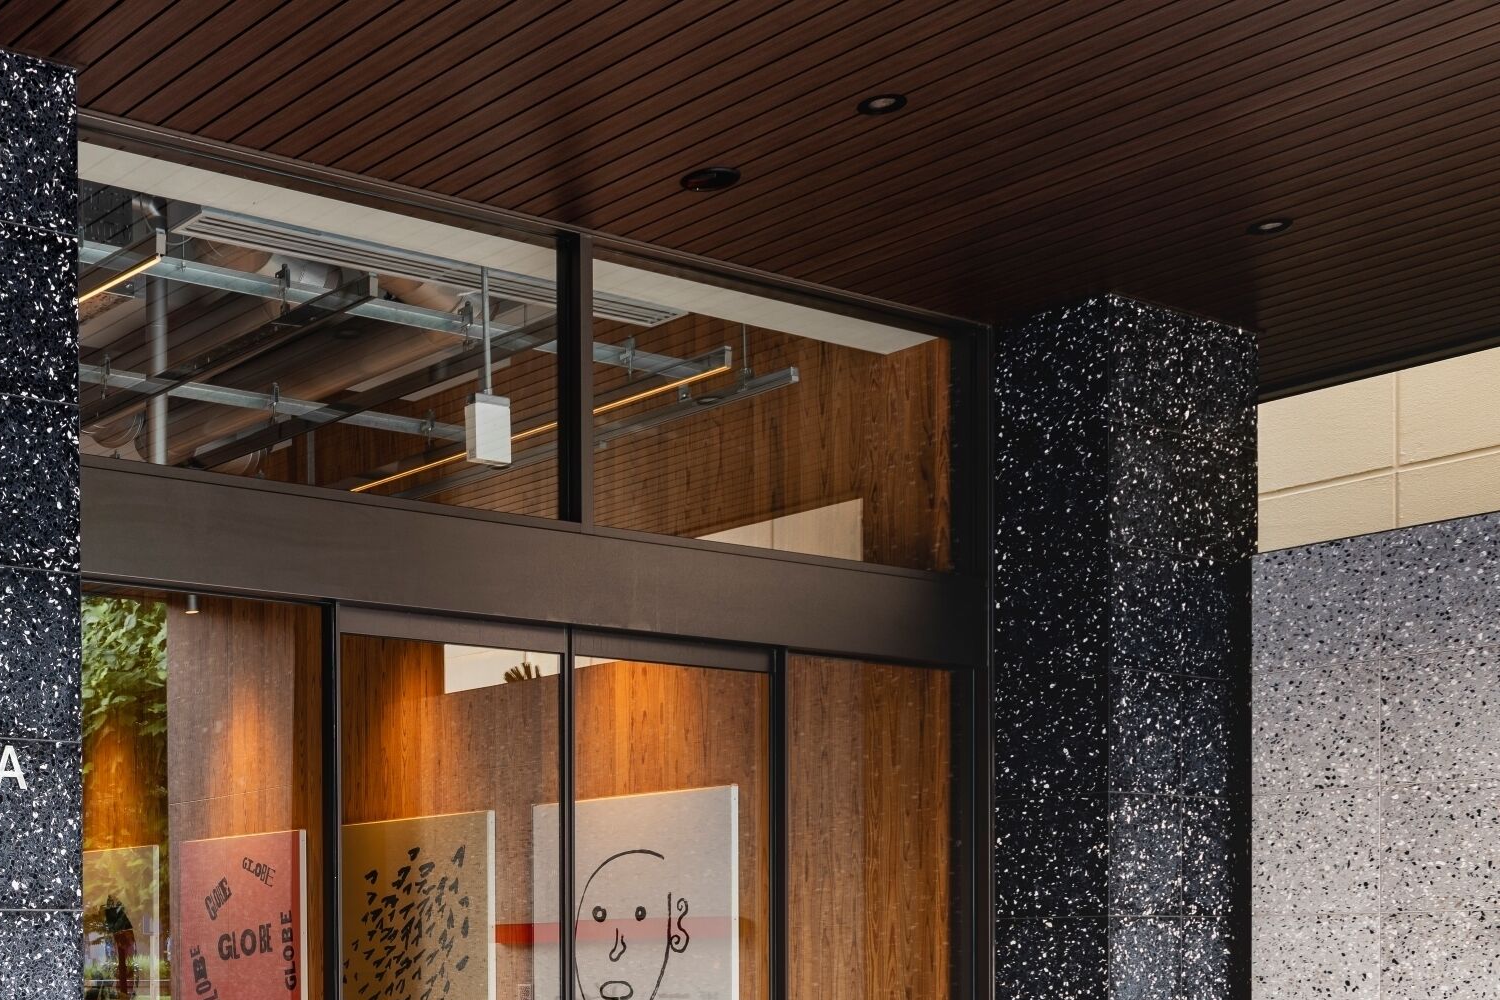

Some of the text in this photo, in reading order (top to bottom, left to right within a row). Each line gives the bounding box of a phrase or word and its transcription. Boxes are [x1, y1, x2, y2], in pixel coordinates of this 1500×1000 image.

[242, 856, 276, 888] GLOBE
[204, 876, 233, 921] GLOBE
[217, 922, 273, 961] GLOBE
[279, 909, 298, 992] GLOBE
